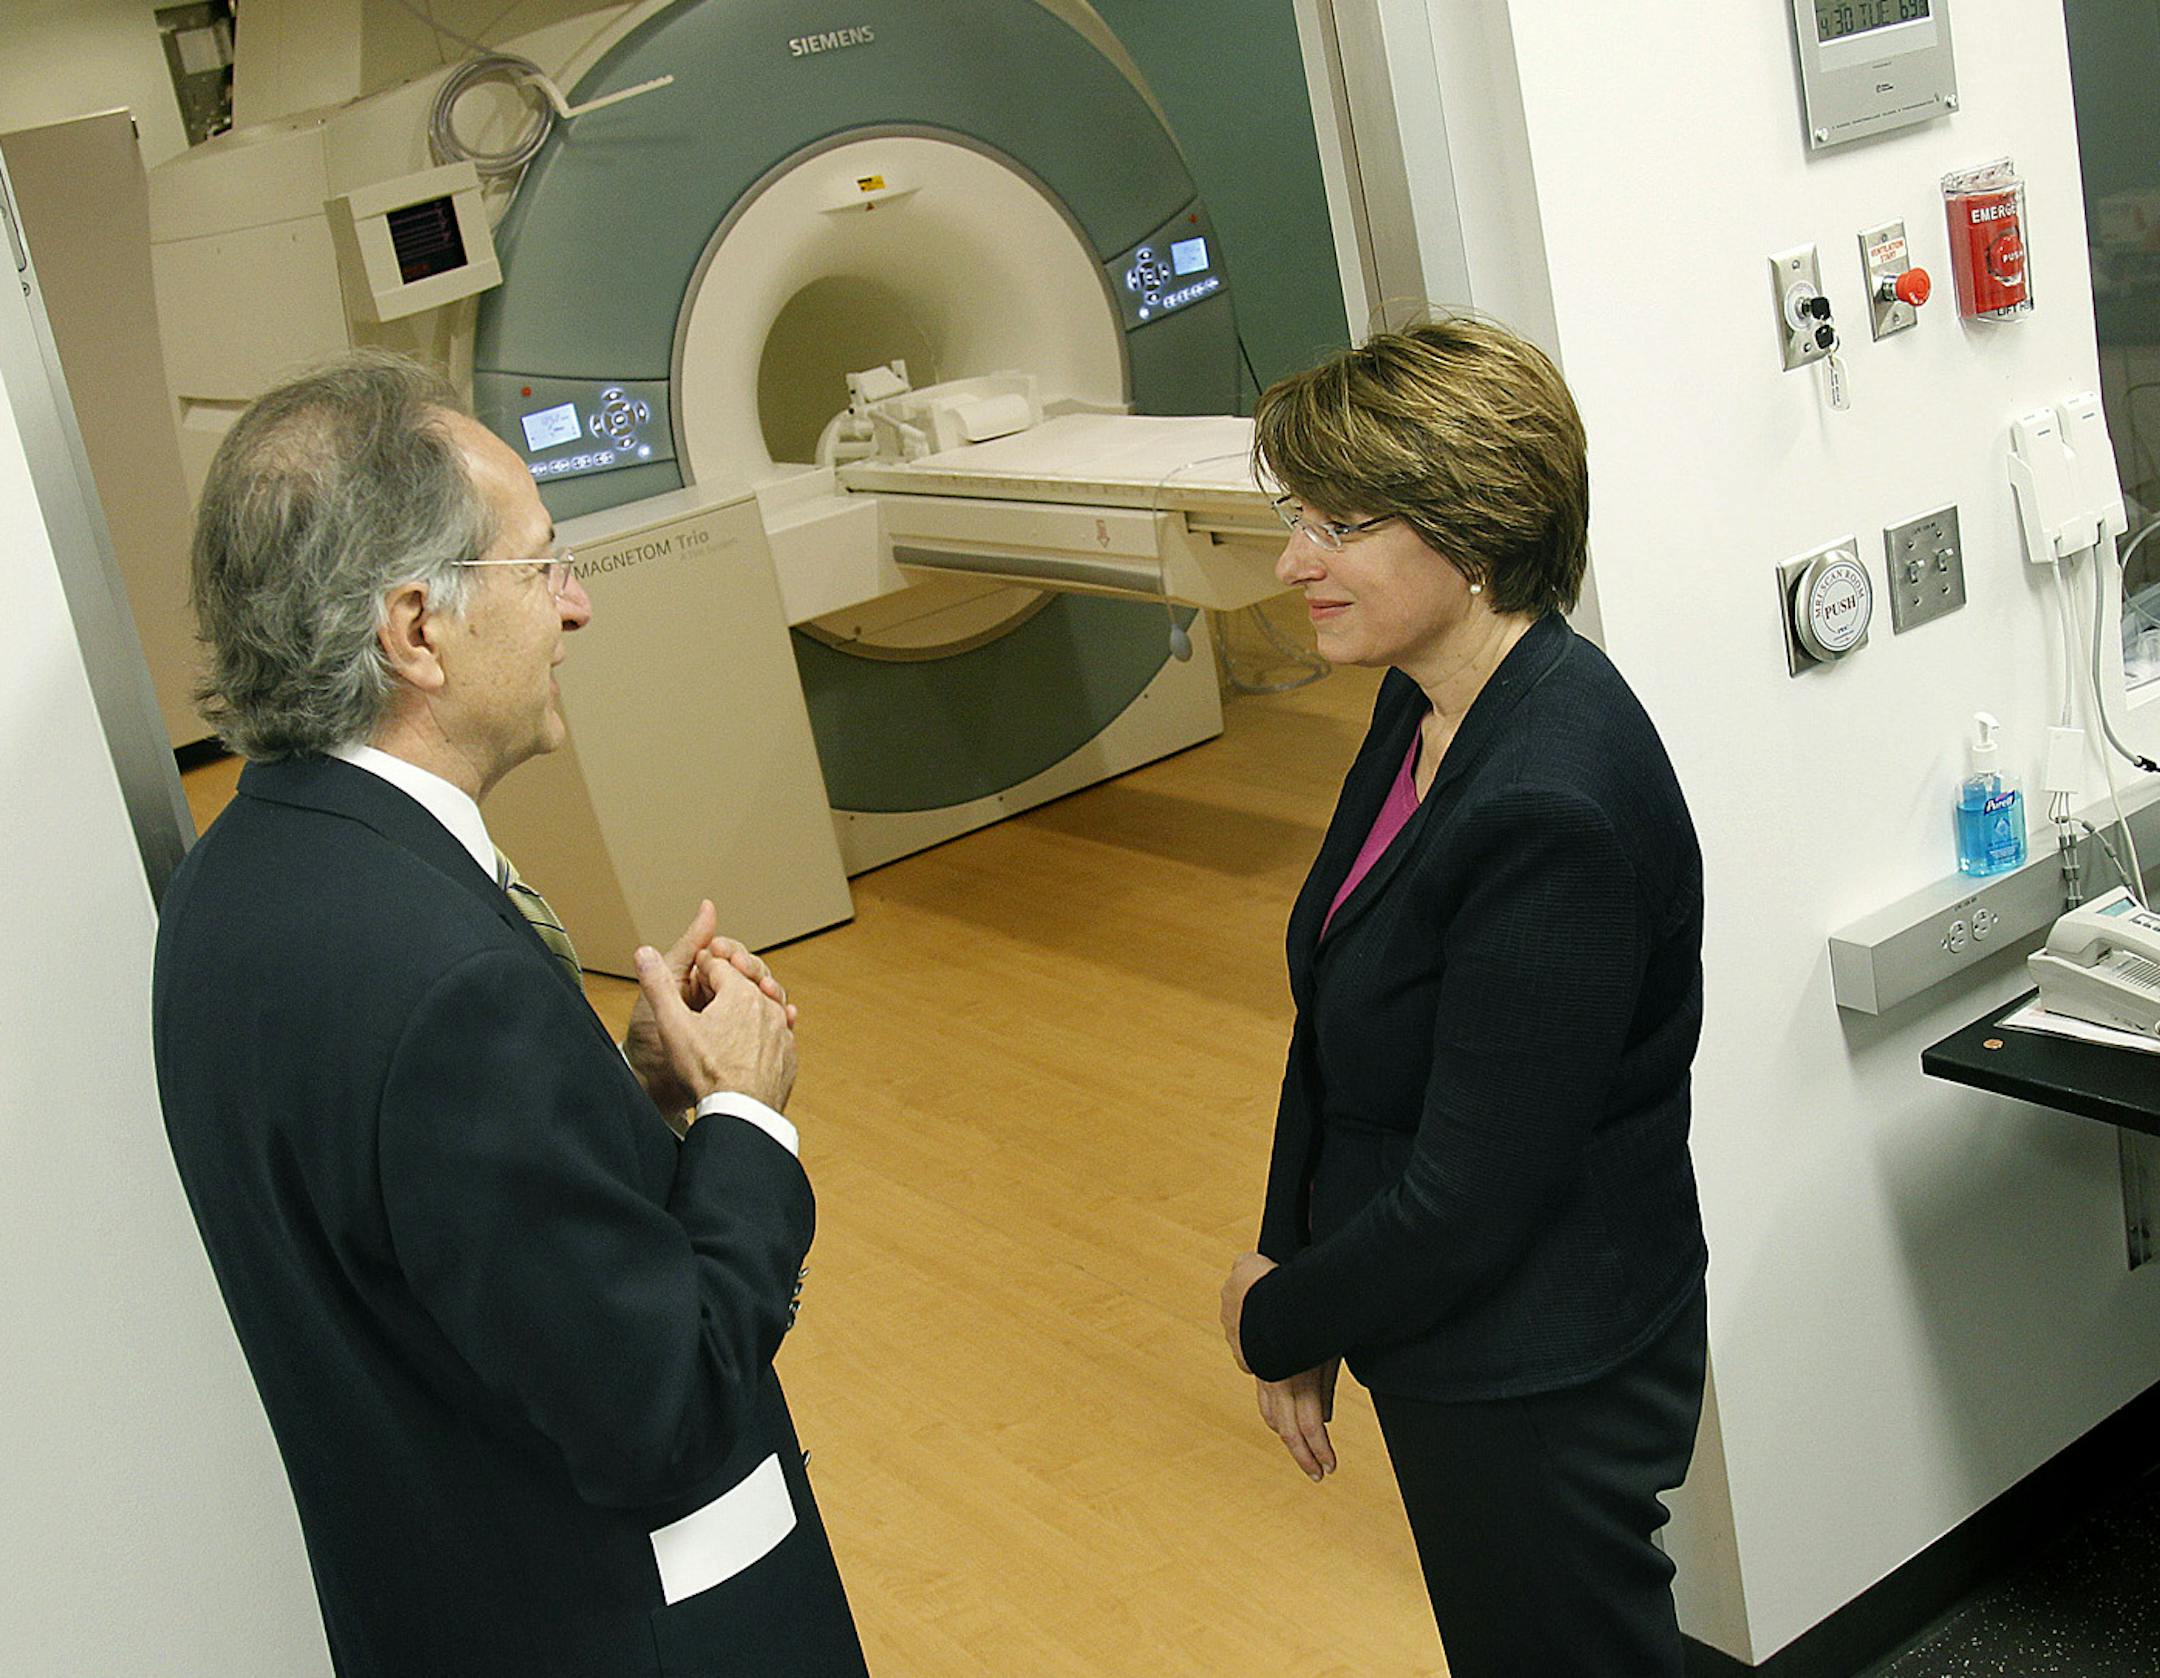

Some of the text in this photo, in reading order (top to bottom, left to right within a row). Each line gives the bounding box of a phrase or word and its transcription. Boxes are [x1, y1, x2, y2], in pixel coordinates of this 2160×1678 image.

[789, 26, 875, 57] SIEMENS
[573, 539, 672, 580] MAGNETOM
[676, 530, 710, 550] Trio
[1820, 569, 1842, 590] SCAN
[1845, 569, 1865, 598] ROOM
[1824, 594, 1857, 620] PUSH
